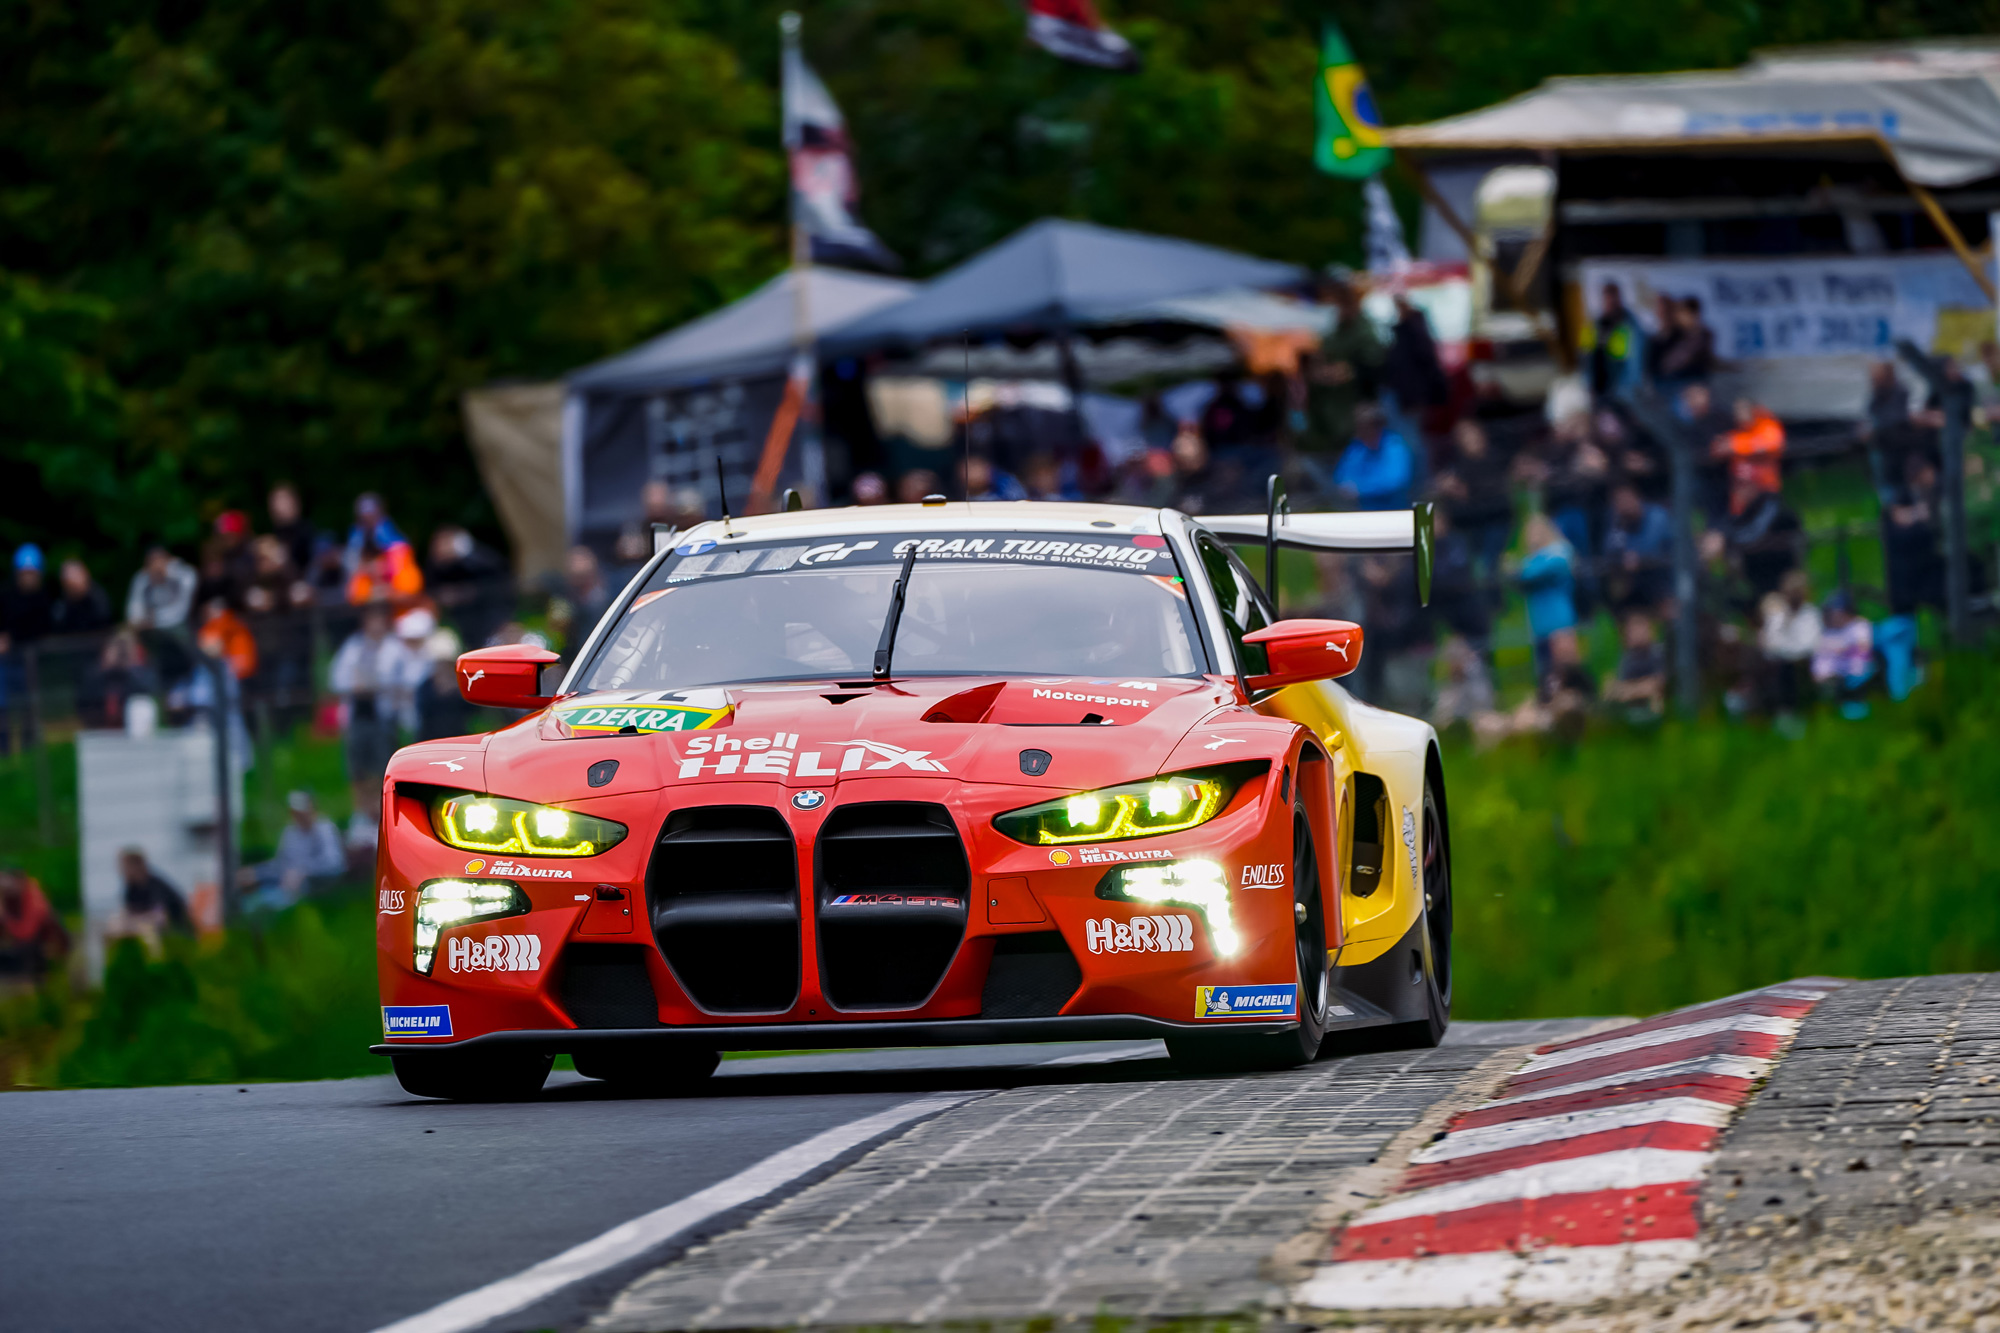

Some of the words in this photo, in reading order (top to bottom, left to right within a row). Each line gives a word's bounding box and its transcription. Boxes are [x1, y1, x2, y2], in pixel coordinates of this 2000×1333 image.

[892, 539, 995, 554] GRAN
[977, 553, 1046, 562] DRIVING
[1050, 556, 1148, 571] SIMULATOR
[1032, 688, 1150, 708] Motorsport
[577, 708, 687, 732] DEKRA
[685, 732, 800, 755] Shell
[677, 739, 950, 780] HELIX
[1078, 847, 1100, 855] Shell
[1080, 850, 1130, 864] HELIX
[1128, 849, 1174, 860] ULTRA
[489, 864, 532, 877] HELIX
[532, 868, 573, 879] ULTRA
[1241, 864, 1285, 886] ENDLESS
[1086, 916, 1157, 955] H&R
[448, 935, 509, 973] H&R
[1233, 994, 1293, 1008] MICHELIN
[389, 1015, 441, 1028] MICHELIN
